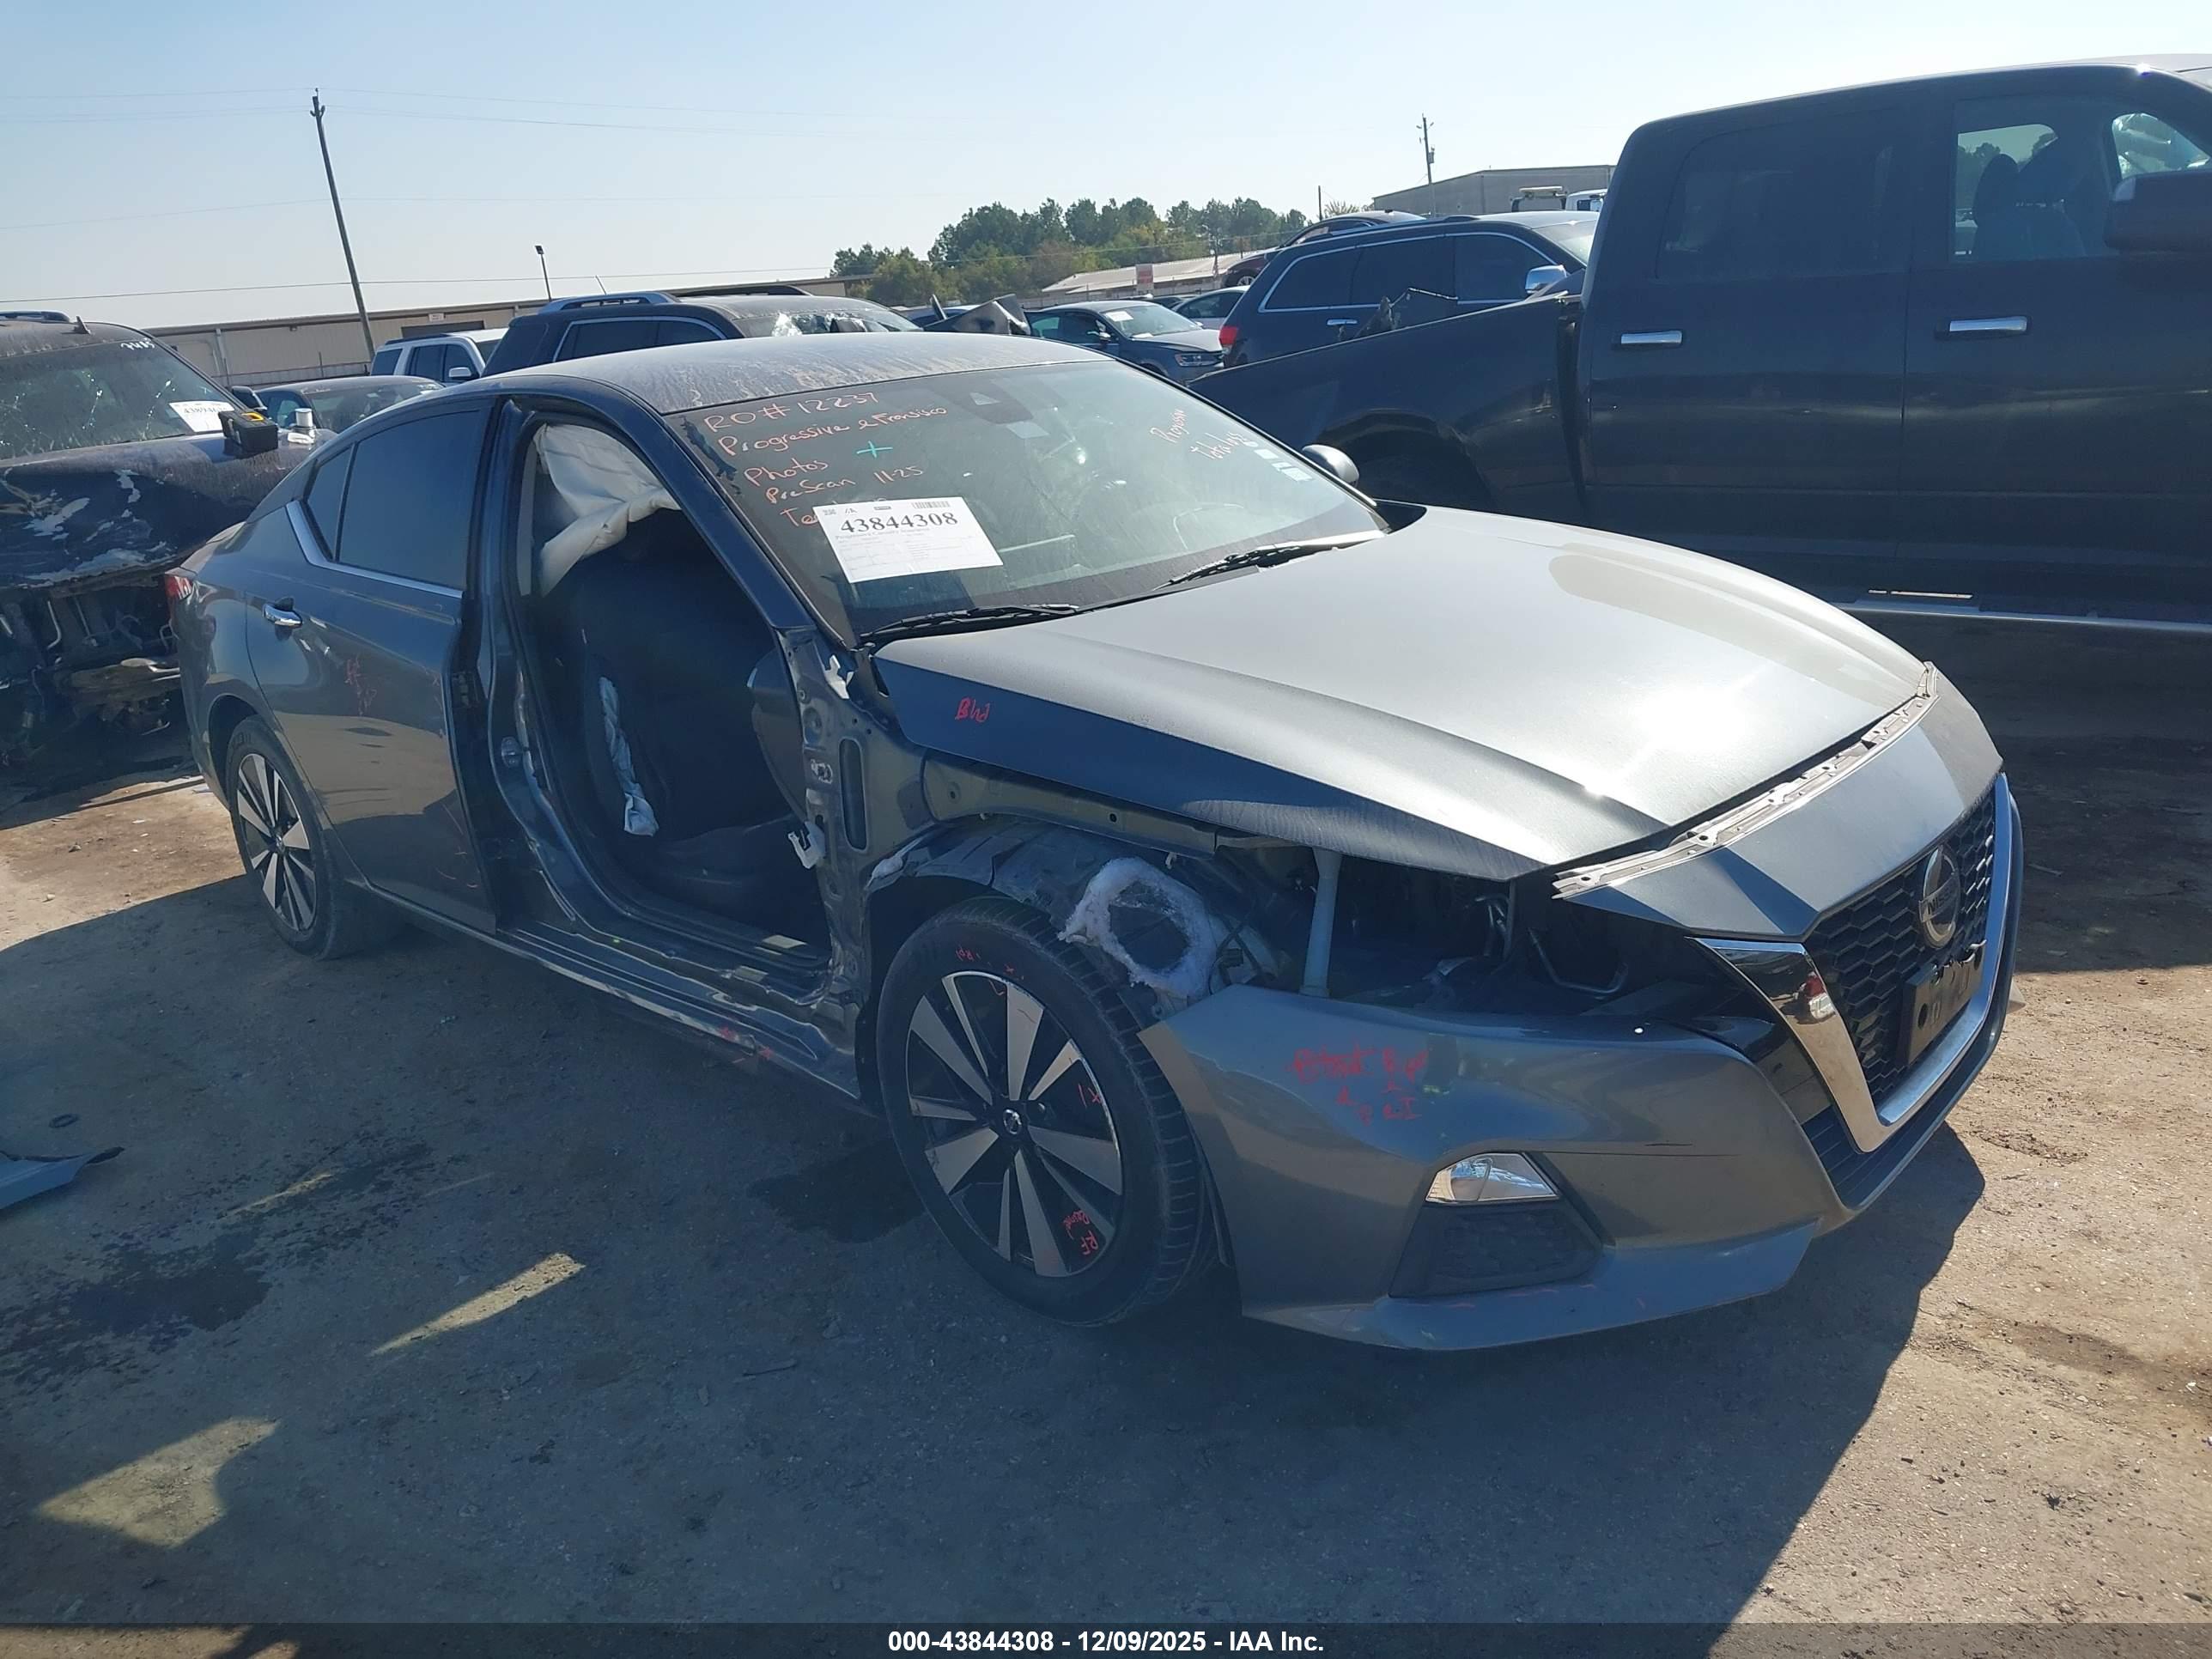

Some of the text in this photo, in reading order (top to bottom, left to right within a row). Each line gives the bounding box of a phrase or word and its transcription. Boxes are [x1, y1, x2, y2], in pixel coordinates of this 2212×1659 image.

[797, 392, 879, 414] 12237
[718, 422, 850, 456] Progressive
[744, 458, 829, 487] Photos
[840, 511, 959, 534] 43844308
